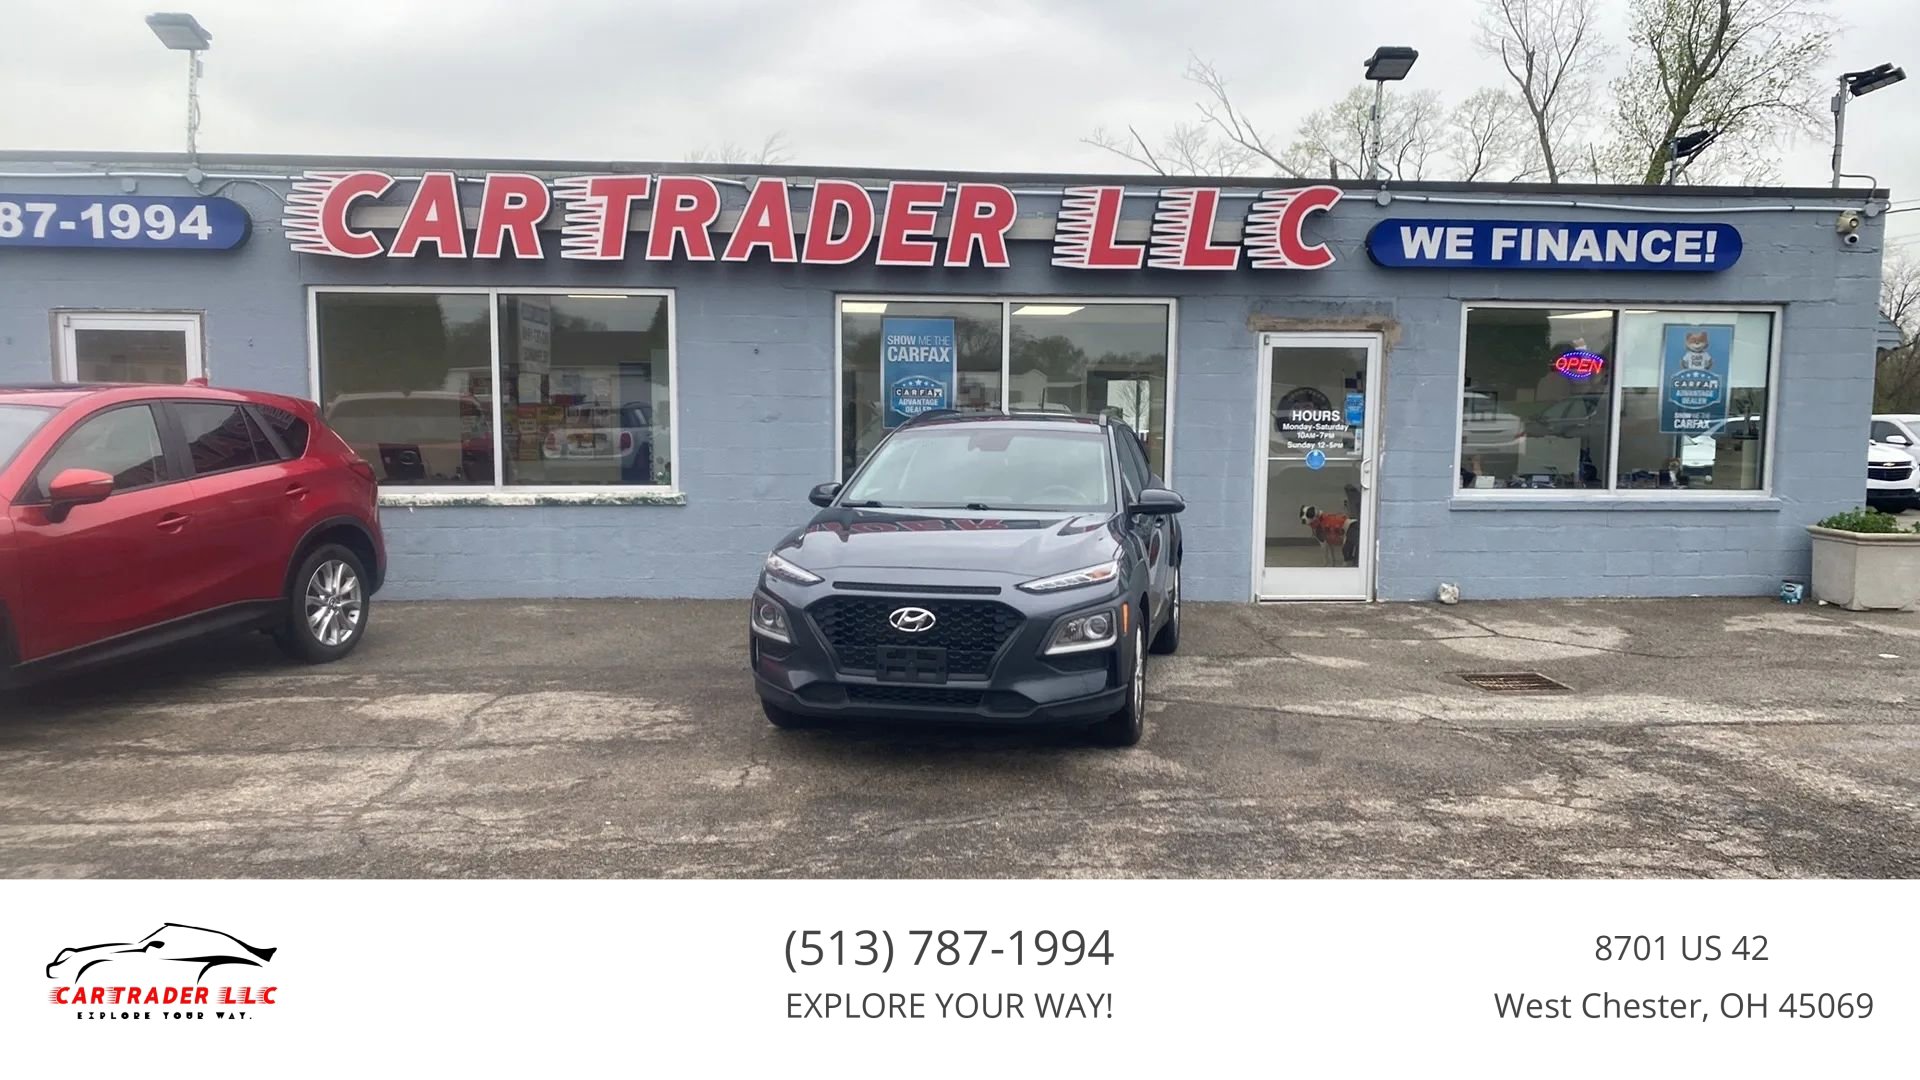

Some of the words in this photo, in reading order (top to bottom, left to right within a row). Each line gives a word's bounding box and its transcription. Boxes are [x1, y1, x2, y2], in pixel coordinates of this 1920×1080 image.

[1051, 185, 1344, 271] LLC
[1400, 226, 1474, 260] WE
[1491, 228, 1717, 264] FINANCE!
[887, 335, 917, 346] SHOW
[918, 335, 933, 346] ME
[934, 335, 951, 346] THE
[887, 346, 951, 362] CARFAX
[1555, 357, 1603, 374] OPEN
[896, 388, 943, 397] CARFAX
[898, 398, 939, 406] ADVANTAGE
[1292, 410, 1341, 422] HOURS
[1282, 423, 1349, 432] Monday-Saturday
[1674, 418, 1710, 429] CARFAX
[1287, 441, 1315, 449] Sunday
